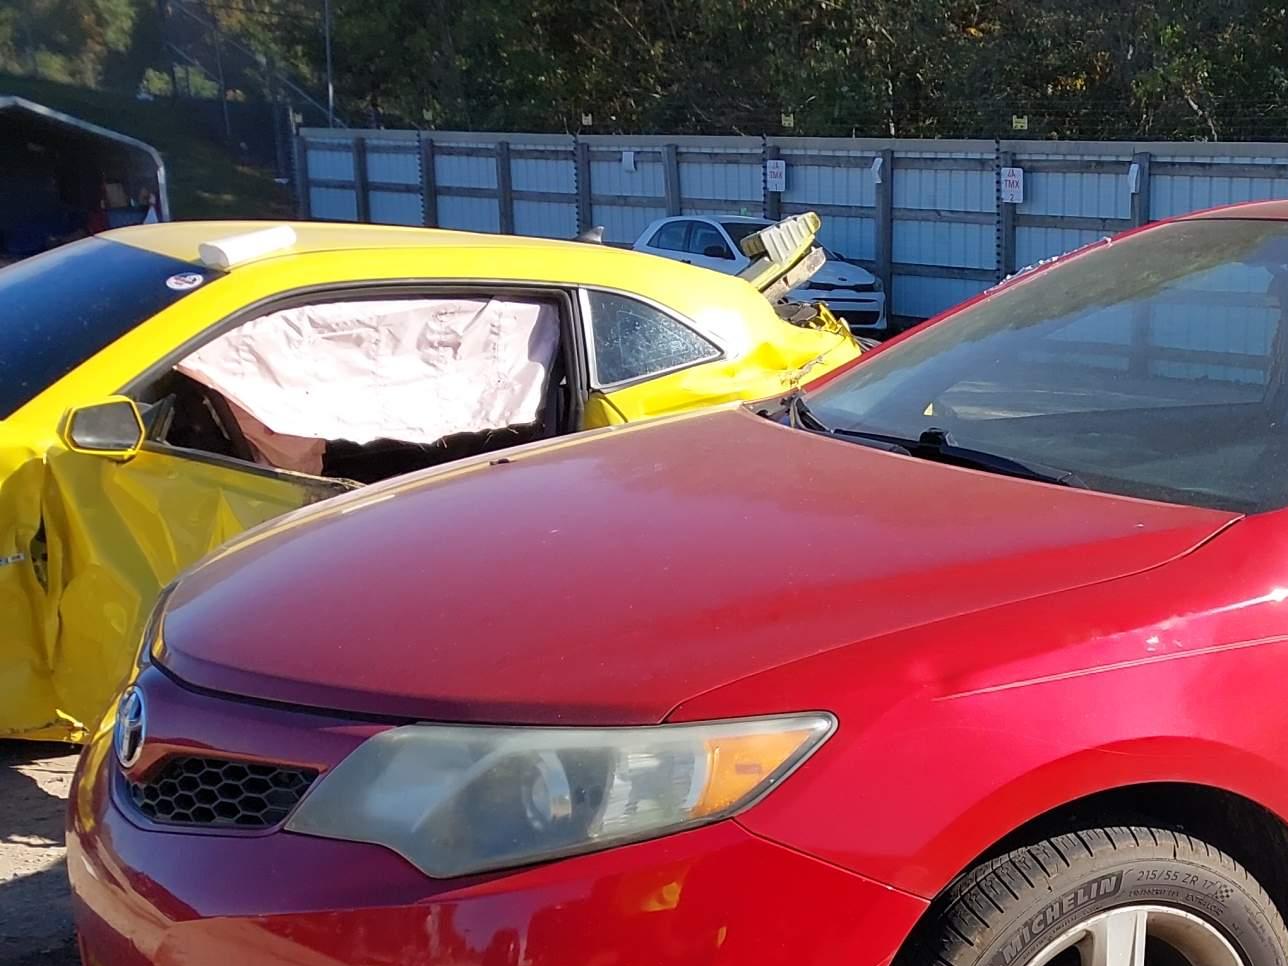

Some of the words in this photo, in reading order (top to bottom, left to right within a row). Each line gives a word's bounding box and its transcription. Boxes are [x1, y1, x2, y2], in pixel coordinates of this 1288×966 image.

[1004, 180, 1020, 189] TMX
[1137, 870, 1180, 881] 215/55
[1182, 873, 1199, 886] ZR
[1201, 880, 1216, 890] 17
[1002, 876, 1117, 964] MICHELIN
